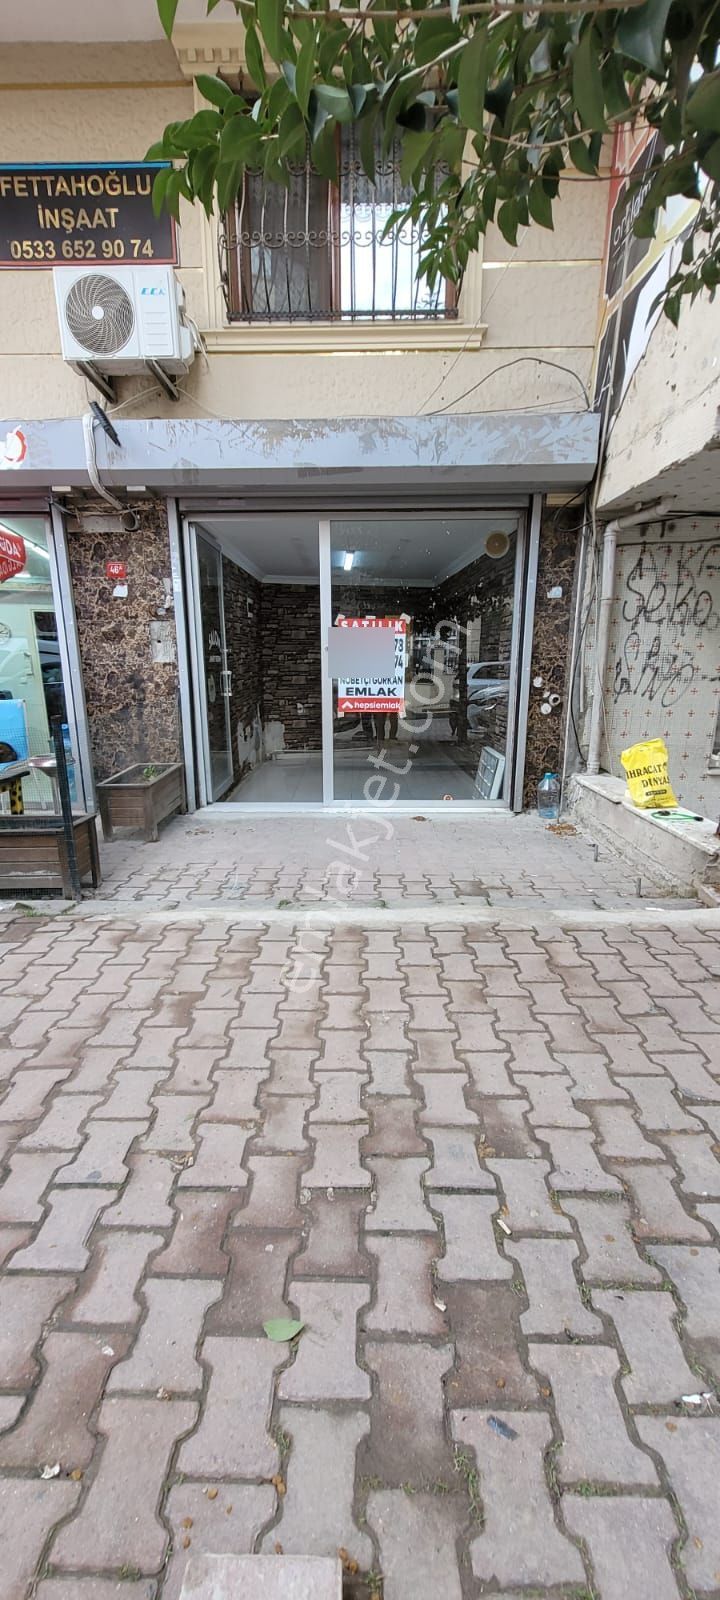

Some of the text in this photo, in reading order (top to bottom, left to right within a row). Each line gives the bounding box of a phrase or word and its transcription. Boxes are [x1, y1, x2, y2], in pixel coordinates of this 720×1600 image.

[0, 171, 151, 197] FETTAHOĞLU
[37, 203, 119, 234] İNŞAAT
[10, 239, 154, 259] 0533 652 90 74
[345, 687, 397, 696] EMLAK
[354, 701, 400, 711] hepsiemlak
